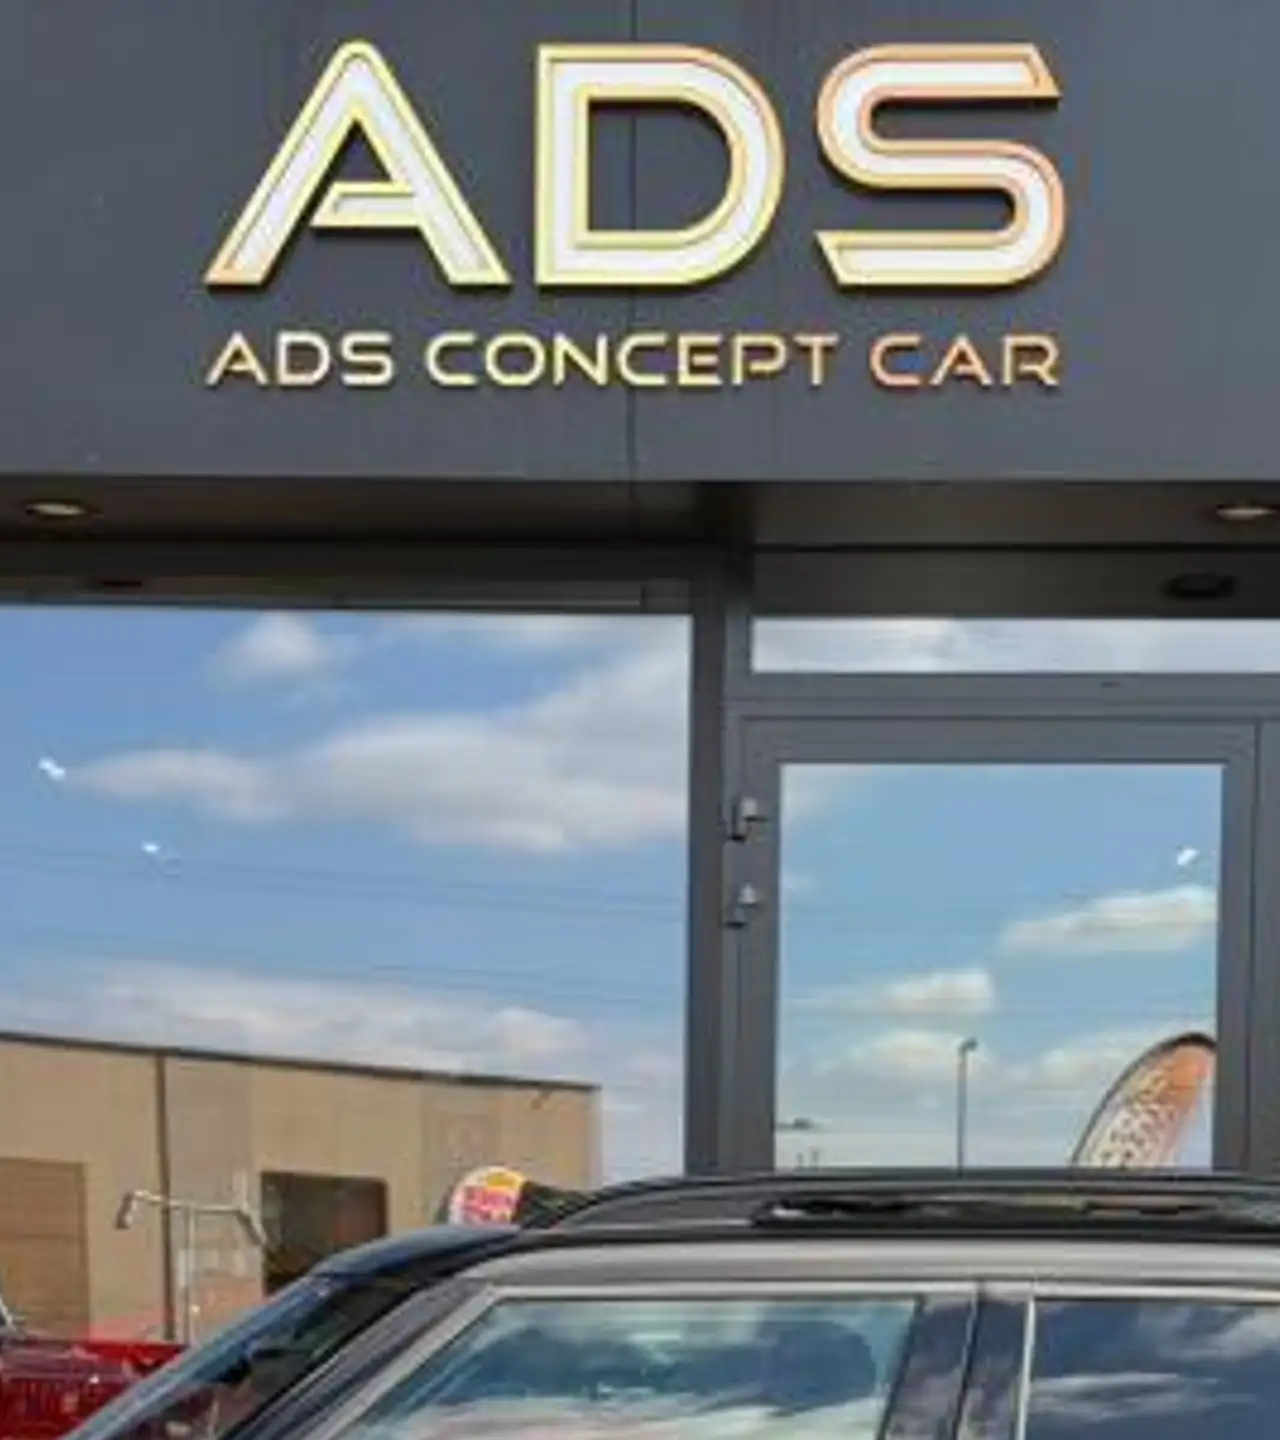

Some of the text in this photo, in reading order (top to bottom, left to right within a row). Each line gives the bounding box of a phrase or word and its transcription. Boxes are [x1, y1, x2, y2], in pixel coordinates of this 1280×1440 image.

[204, 39, 1066, 288] ADS
[205, 332, 1062, 390] ADS CONCEPT CAR
